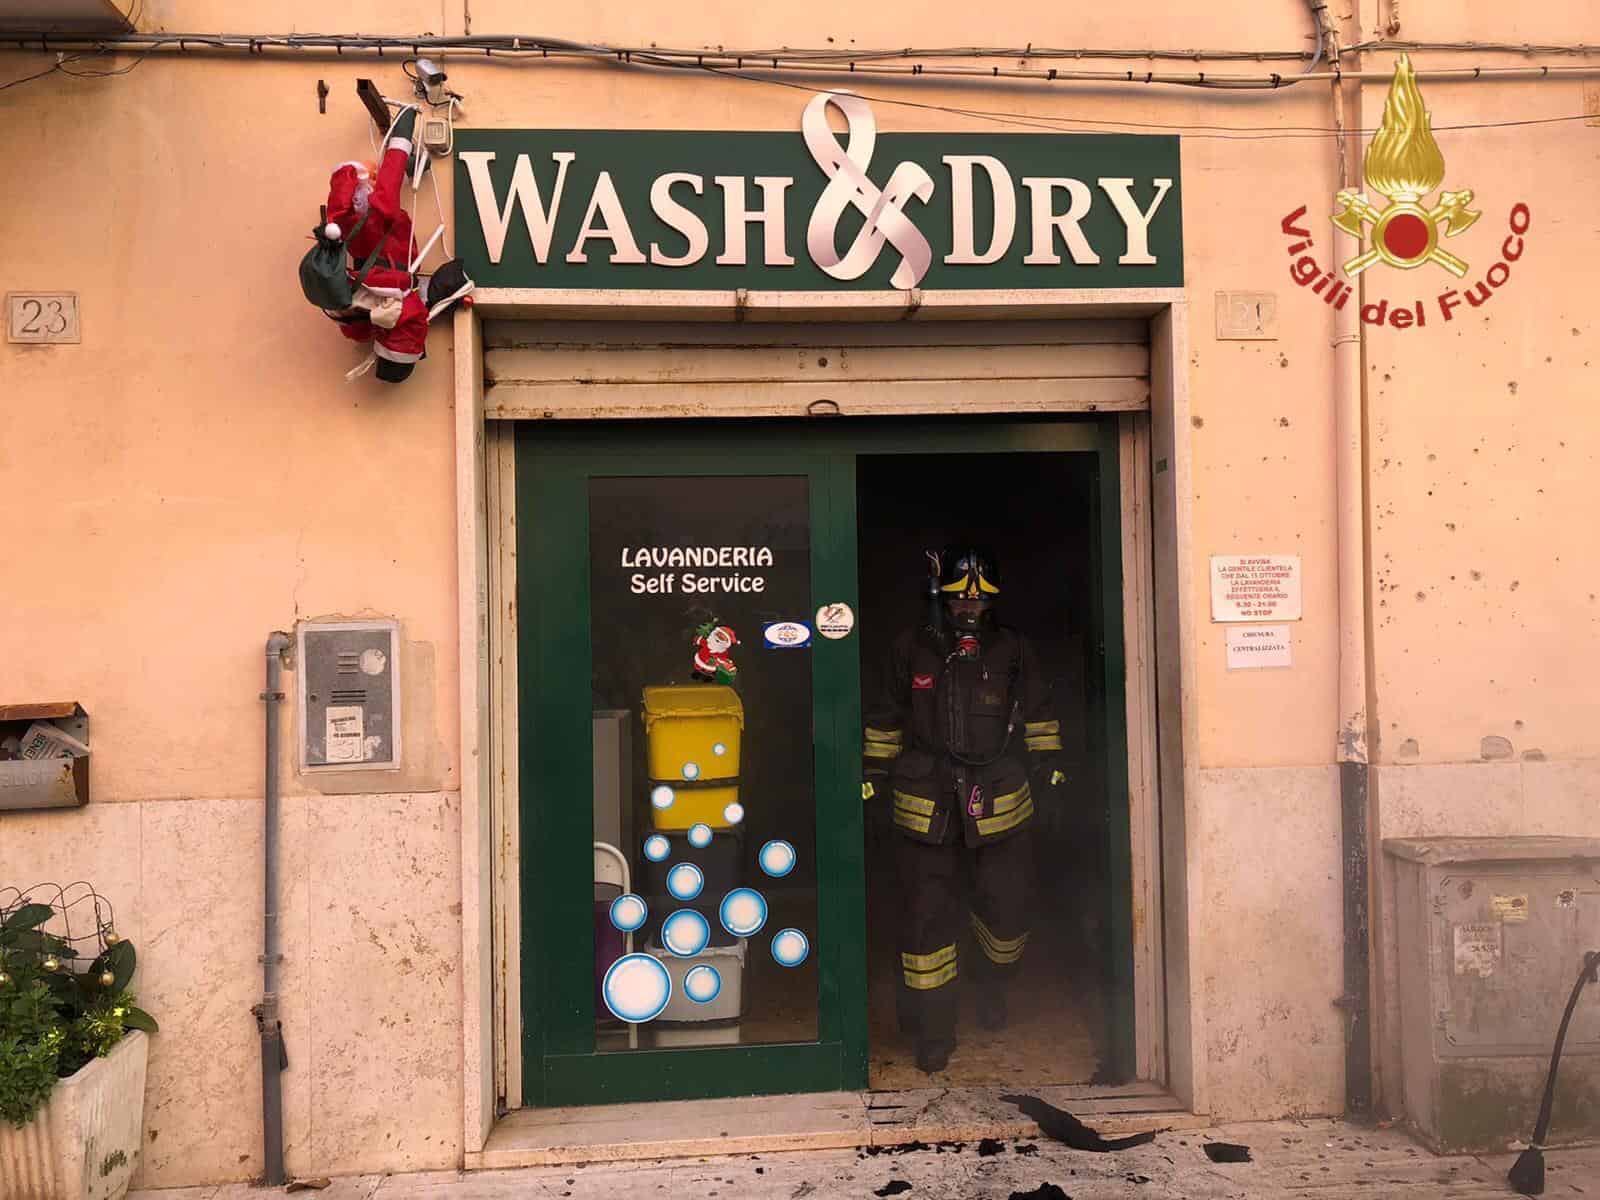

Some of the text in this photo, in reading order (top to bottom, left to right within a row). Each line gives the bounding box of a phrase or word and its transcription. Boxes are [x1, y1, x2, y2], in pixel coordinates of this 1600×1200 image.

[458, 89, 1173, 289] WASH & DRY
[22, 300, 66, 334] 23
[621, 547, 774, 567] LAVANDERIA
[631, 572, 765, 594] Self Service
